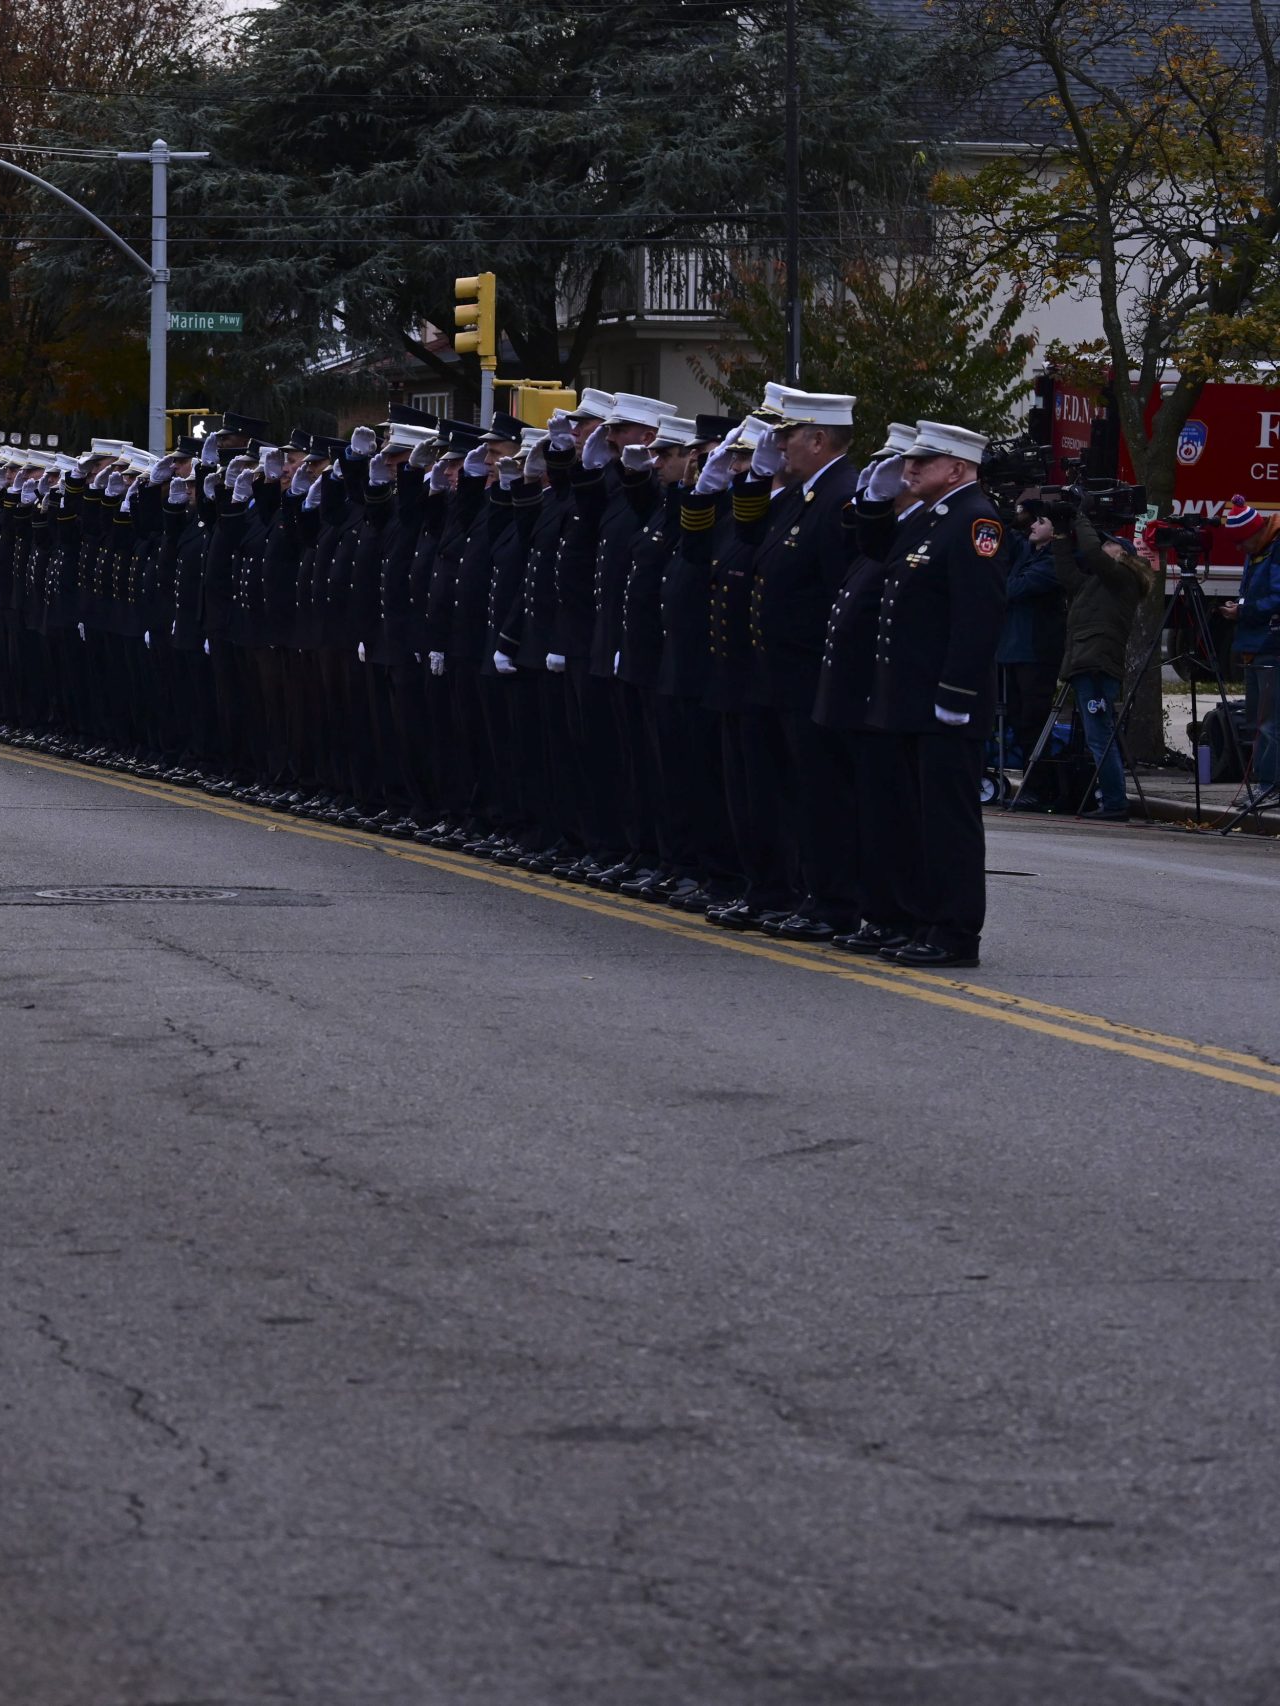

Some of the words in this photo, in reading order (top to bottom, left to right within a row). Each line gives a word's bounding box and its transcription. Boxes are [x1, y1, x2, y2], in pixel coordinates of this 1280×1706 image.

[171, 314, 214, 329] Marine
[220, 315, 240, 326] Pkwy
[1250, 463, 1279, 480] CE
